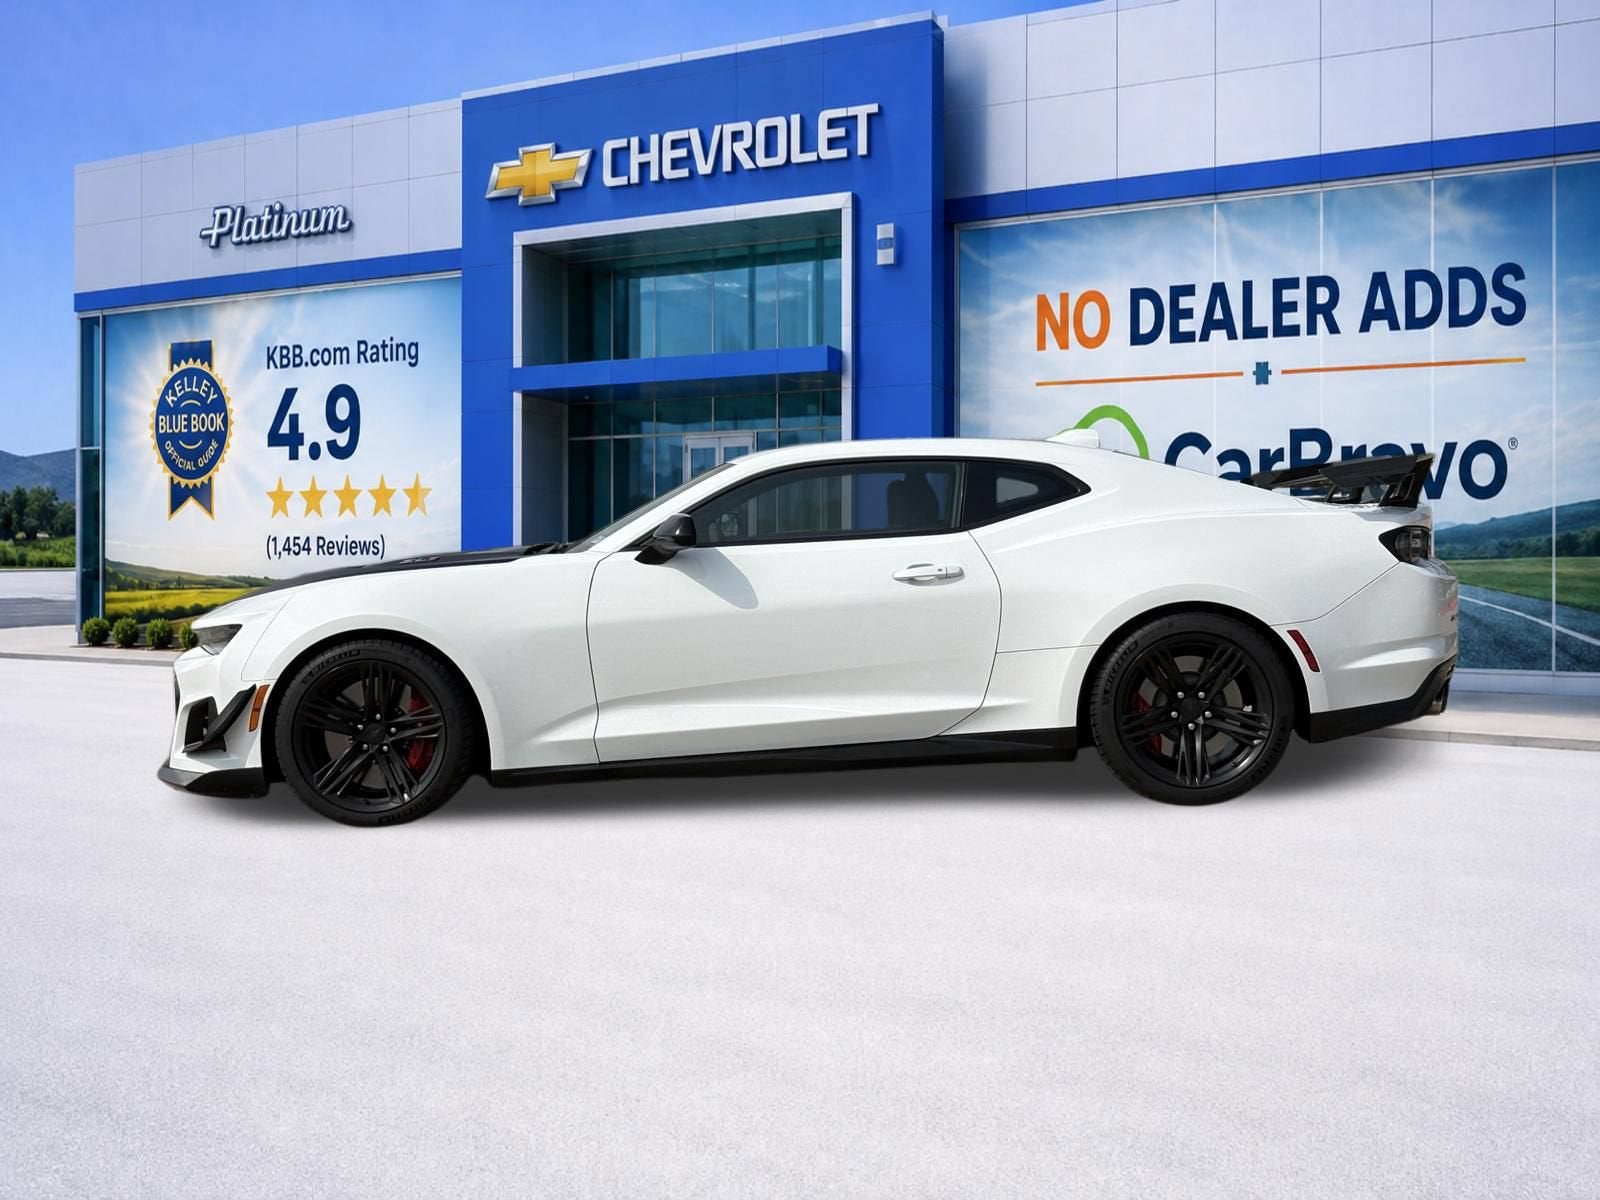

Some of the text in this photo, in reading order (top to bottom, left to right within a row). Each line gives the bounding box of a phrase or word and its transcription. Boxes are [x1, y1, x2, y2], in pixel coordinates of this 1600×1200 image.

[602, 102, 879, 188] CHEVROLET
[200, 201, 352, 248] Platinum
[1036, 261, 1527, 352] NO DEALER ADDS
[266, 336, 419, 370] KBB.com Rating
[165, 375, 218, 408] KELLEY
[158, 412, 225, 433] BLUE BOOK
[266, 383, 361, 461] 4.9
[164, 440, 197, 471] OFFICIAL
[266, 533, 385, 560] (1,454 Reviews)
